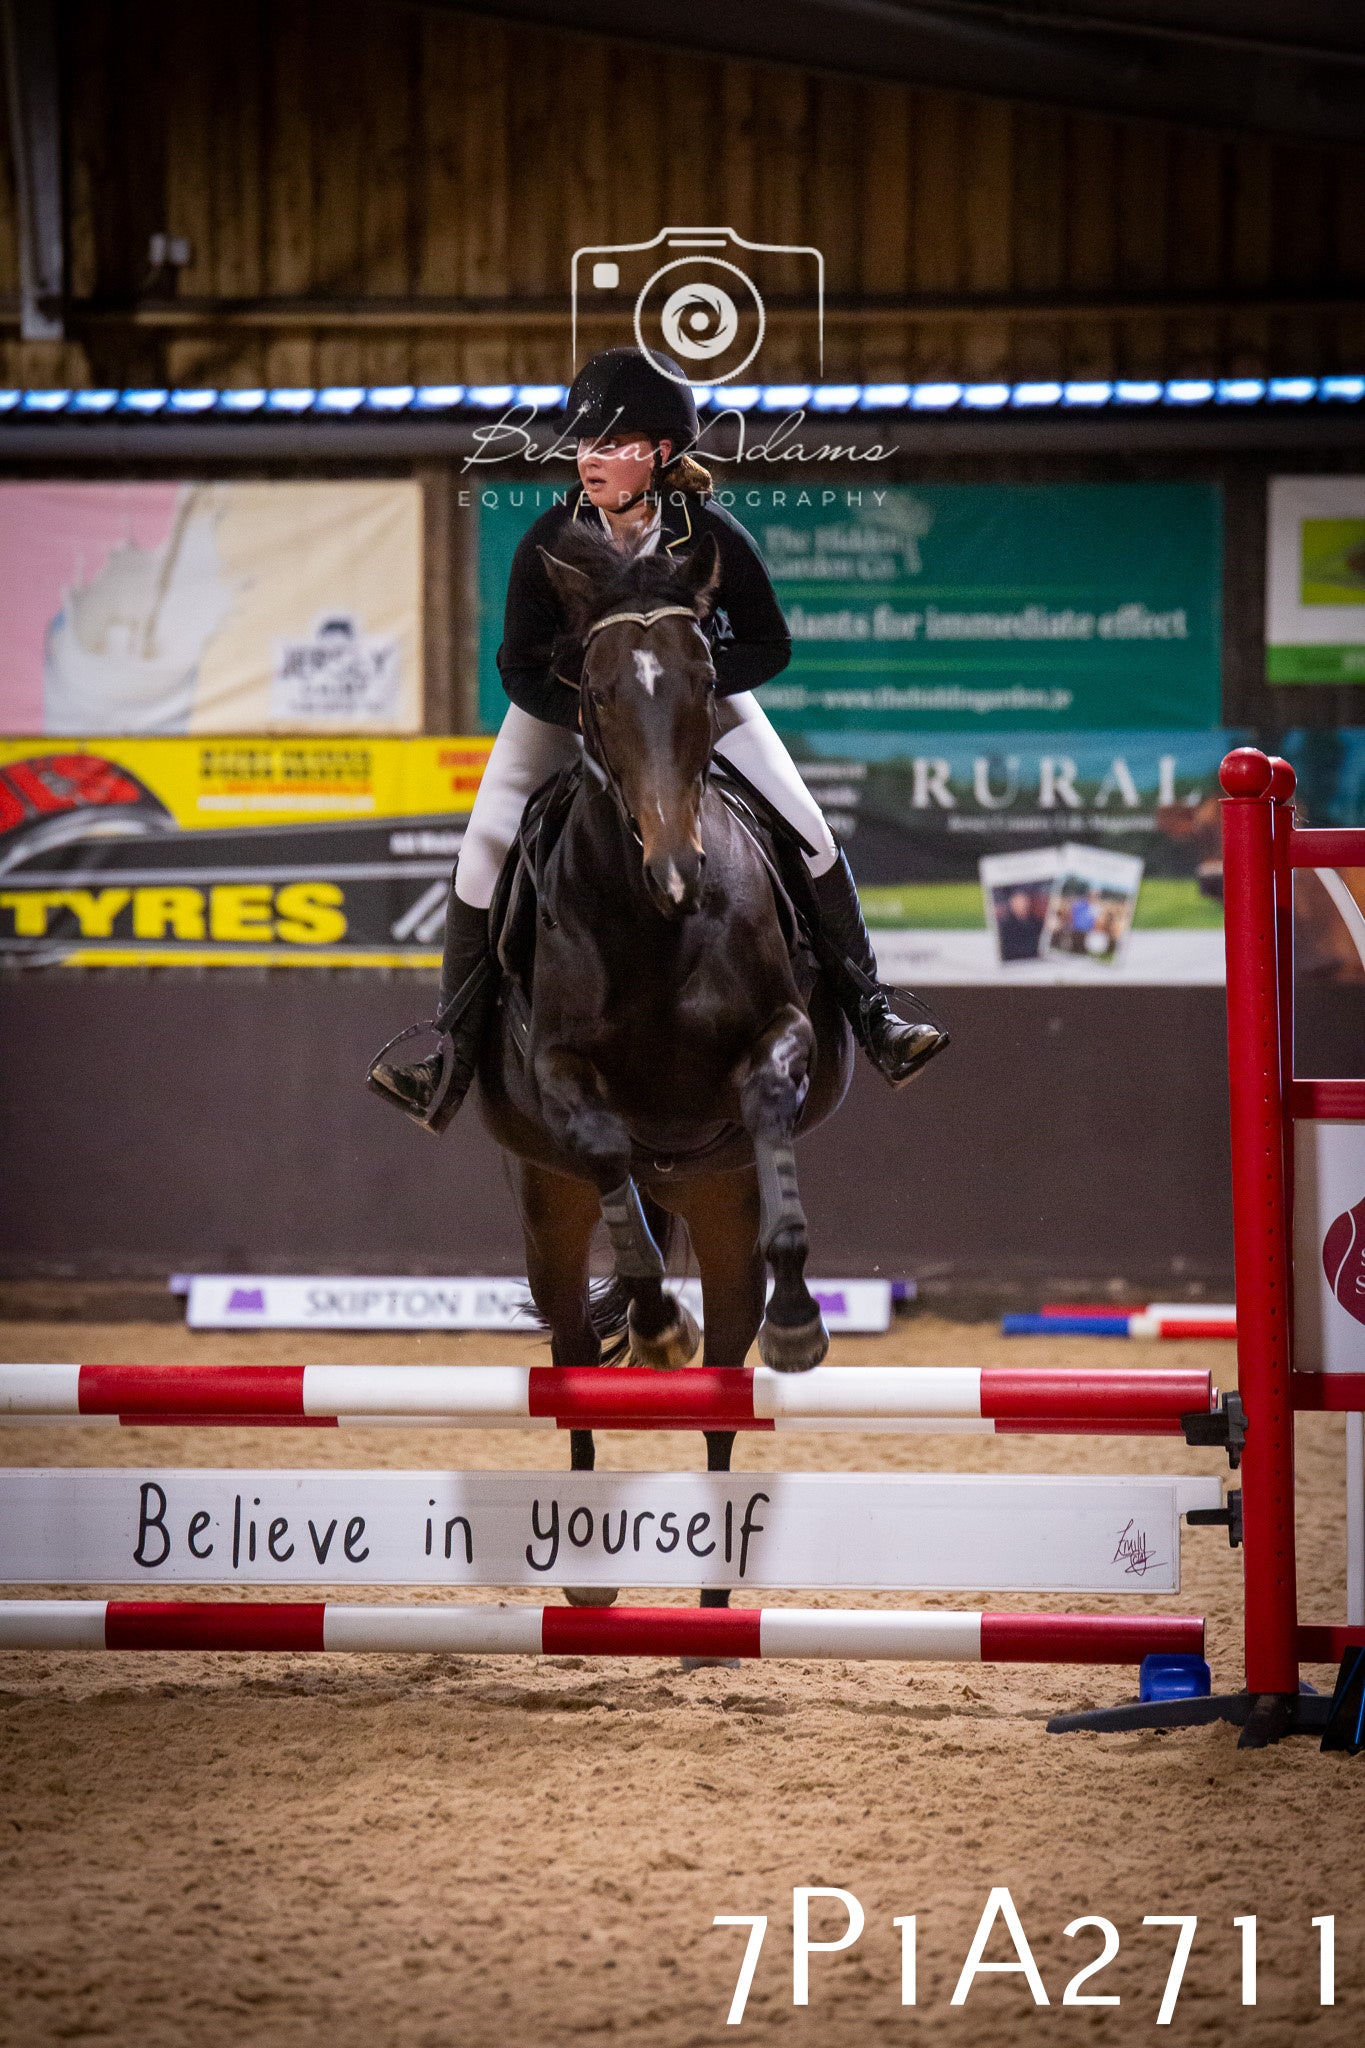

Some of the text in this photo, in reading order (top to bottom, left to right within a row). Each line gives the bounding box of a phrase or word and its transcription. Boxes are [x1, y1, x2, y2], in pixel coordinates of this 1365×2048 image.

[912, 756, 1201, 810] RURAL
[0, 882, 347, 944] TYRES
[304, 1288, 459, 1317] SKIPTON
[134, 1482, 770, 1578] Believe in yourself
